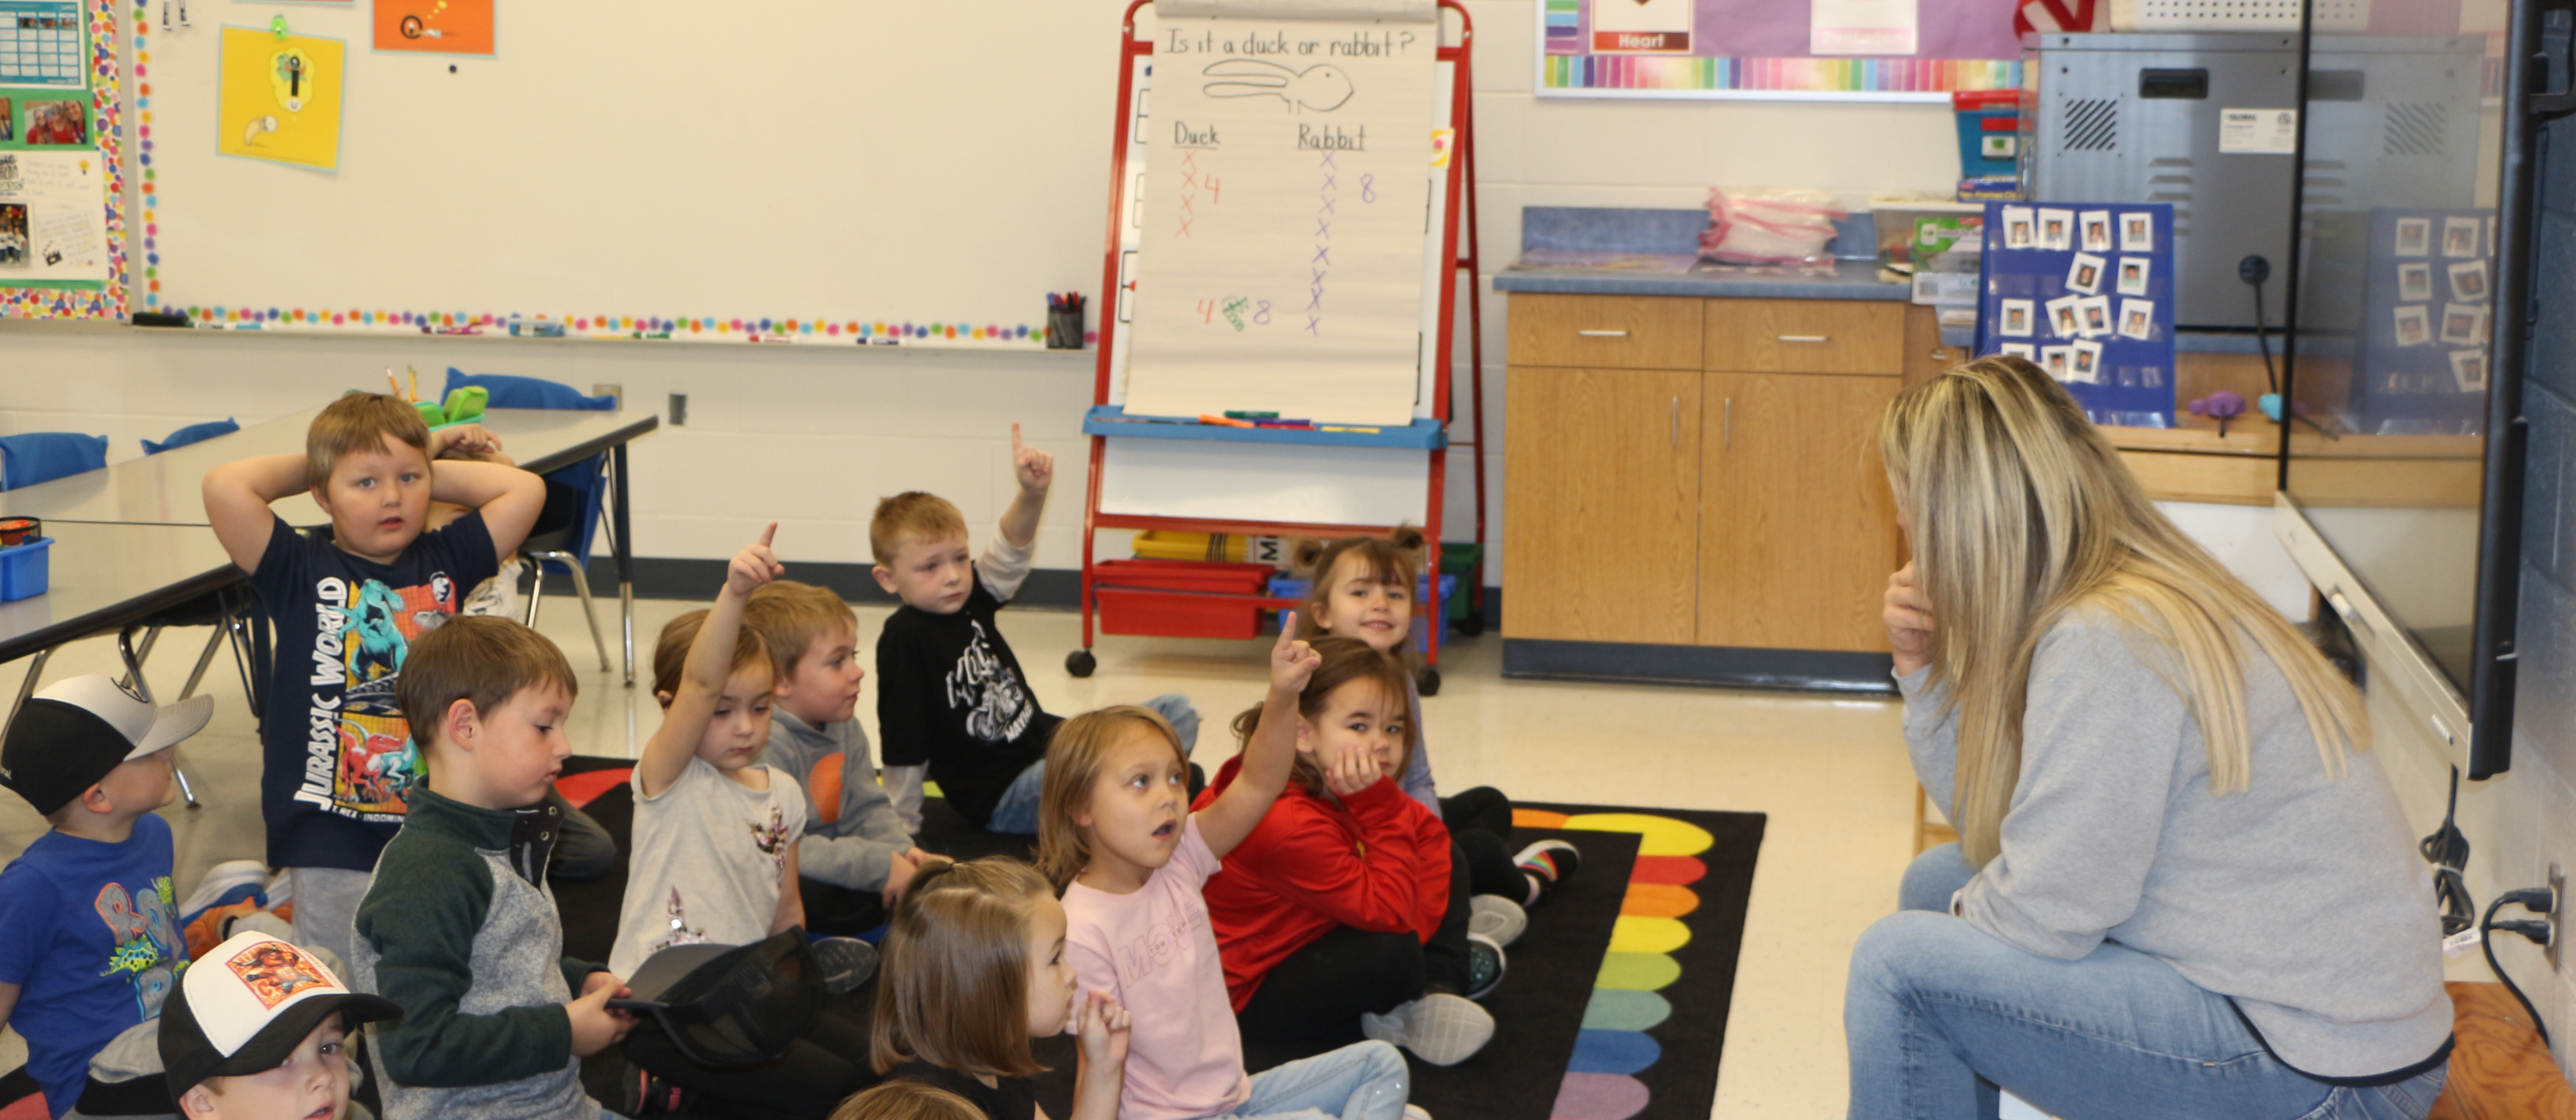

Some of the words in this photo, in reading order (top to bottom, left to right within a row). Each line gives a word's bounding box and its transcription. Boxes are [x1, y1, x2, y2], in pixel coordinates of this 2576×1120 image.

[1165, 28, 1188, 53] Is
[1198, 30, 1214, 53] it
[1223, 39, 1234, 53] a
[1242, 31, 1289, 55] duck
[1298, 40, 1319, 55] or
[1618, 33, 1665, 48] Heart
[1174, 121, 1221, 145] Duck
[1298, 123, 1368, 149] Rabbit
[1204, 174, 1220, 204] 4
[1360, 173, 1376, 204] 8
[1197, 299, 1214, 324] 4
[1253, 300, 1271, 325] 8
[310, 577, 347, 686] WORLD
[294, 693, 341, 811] JURASSIC
